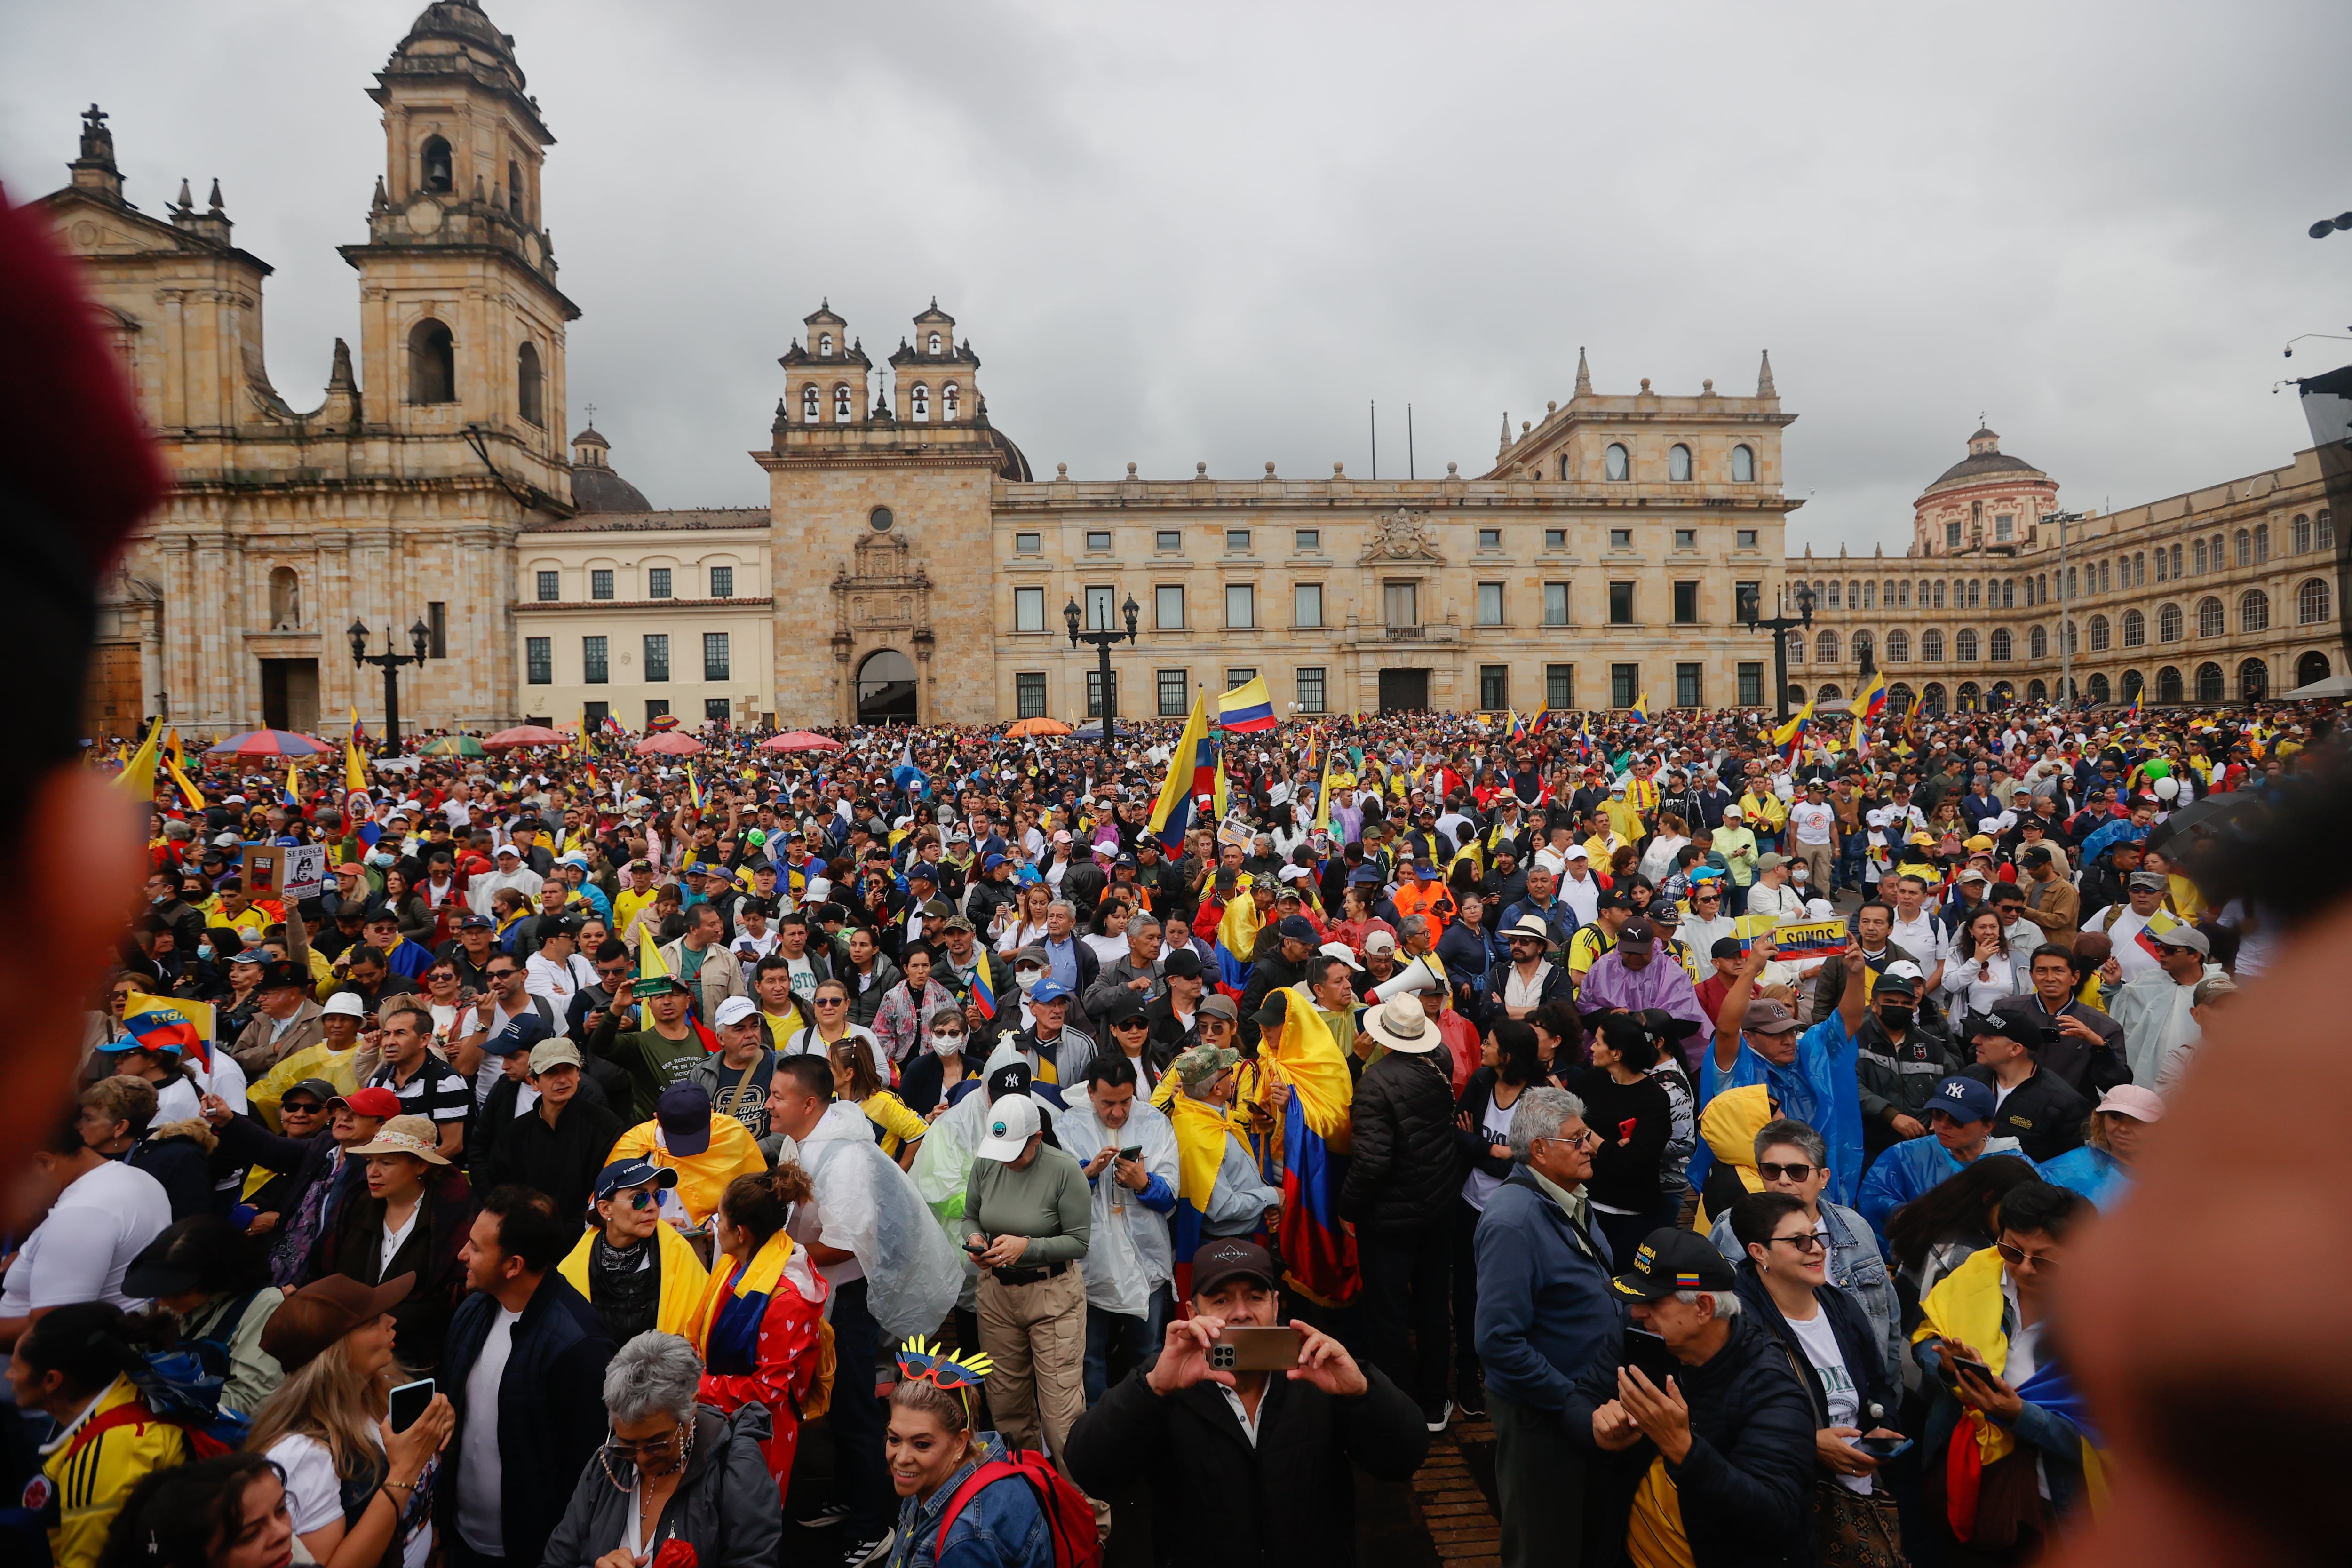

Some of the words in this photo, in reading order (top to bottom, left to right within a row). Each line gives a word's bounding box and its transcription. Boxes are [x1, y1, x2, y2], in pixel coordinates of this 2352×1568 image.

[1230, 828, 1246, 836] PETRO!
[299, 847, 322, 856] BUSCA
[1786, 928, 1835, 951] SOMOS
[790, 971, 817, 992] OSTO
[1770, 1005, 1786, 1018] LA
[661, 1061, 673, 1070] SER
[1004, 1073, 1019, 1088] NY
[1945, 1082, 1965, 1099] NY
[739, 1097, 766, 1114] and
[735, 1112, 762, 1122] ace
[623, 1163, 646, 1174] FUERZA
[1638, 1242, 1656, 1260] MBIA
[1634, 1258, 1650, 1274] RANO
